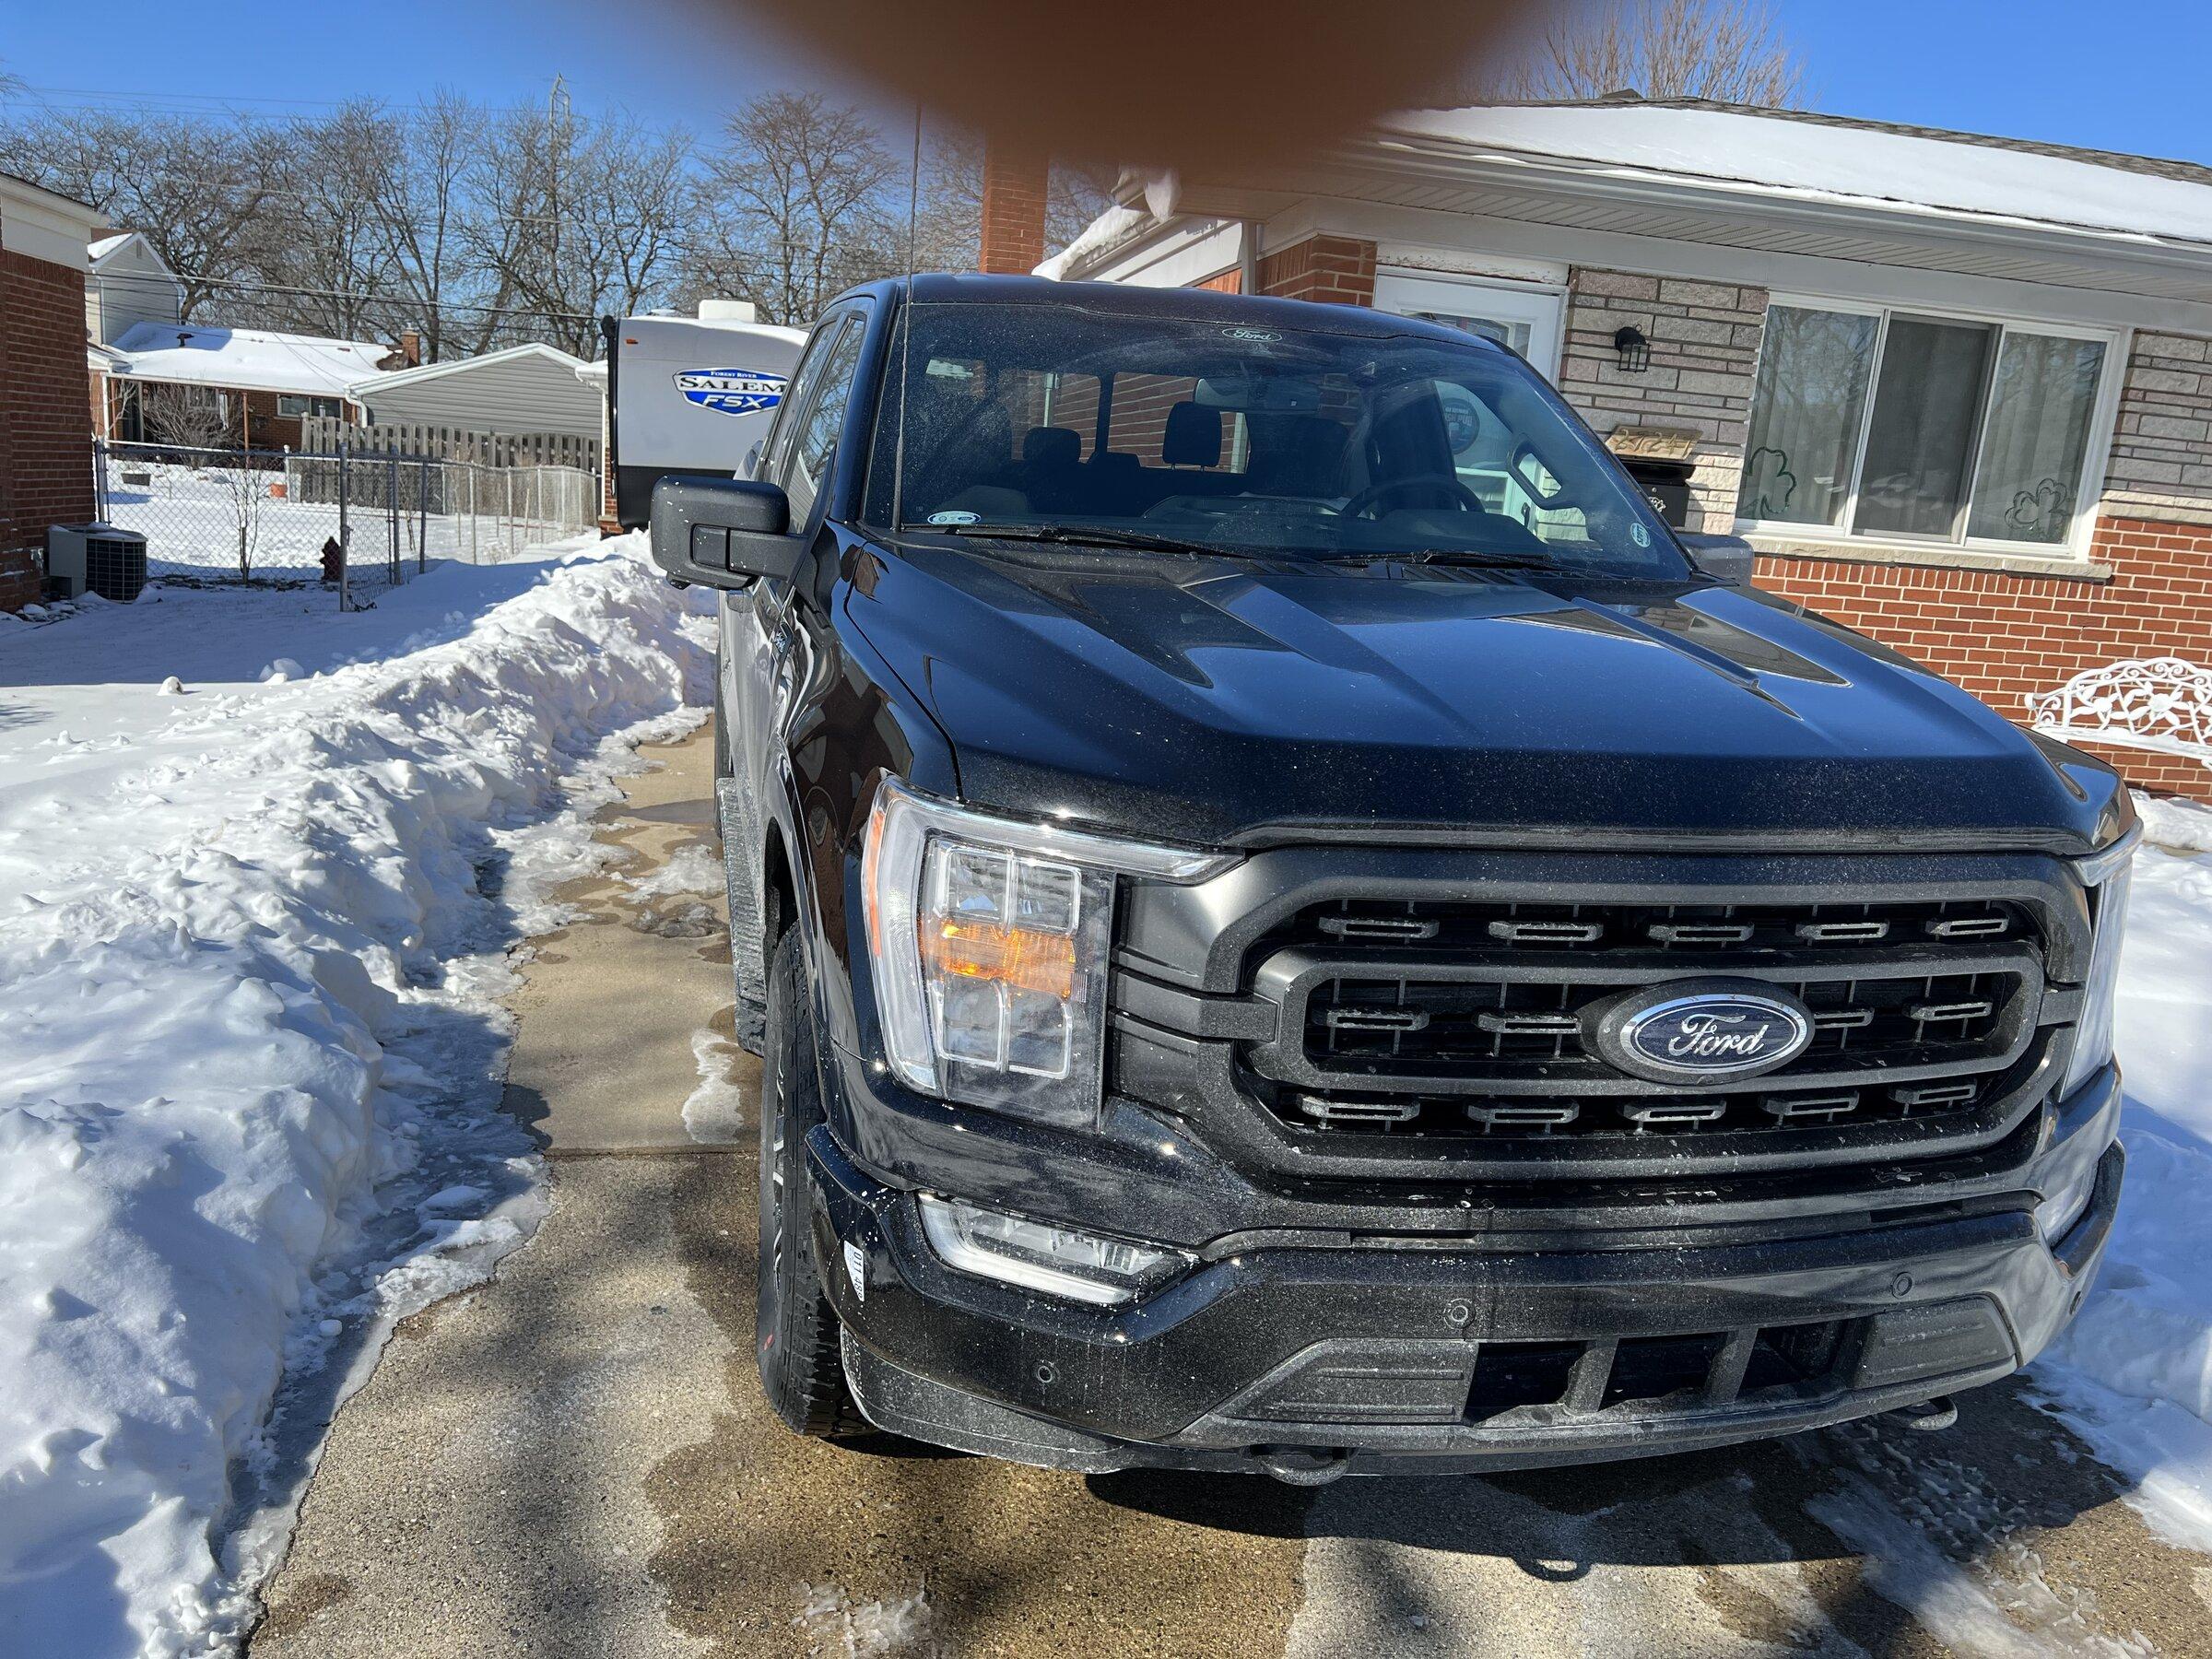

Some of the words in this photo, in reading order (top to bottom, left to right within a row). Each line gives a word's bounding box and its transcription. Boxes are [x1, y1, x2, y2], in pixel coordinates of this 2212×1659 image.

[1233, 330, 1272, 340] Ford
[680, 377, 783, 393] SALEM
[702, 394, 769, 408] FSX
[1615, 429, 1691, 459] 21241
[1668, 1013, 1770, 1057] Ford
[853, 1252, 863, 1274] 011
